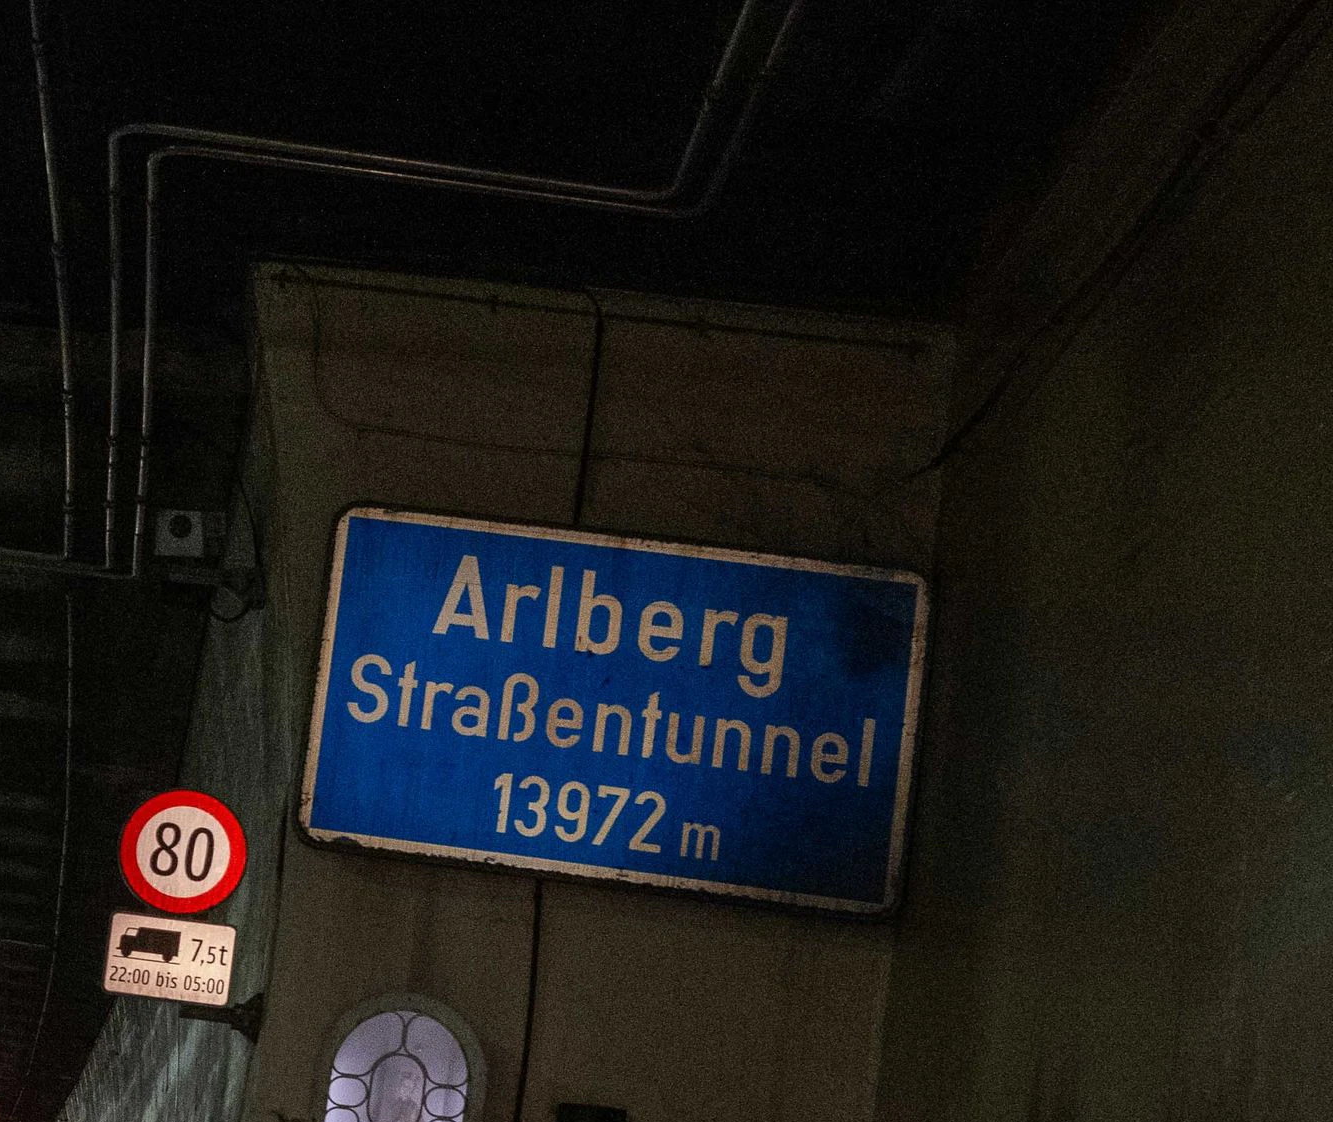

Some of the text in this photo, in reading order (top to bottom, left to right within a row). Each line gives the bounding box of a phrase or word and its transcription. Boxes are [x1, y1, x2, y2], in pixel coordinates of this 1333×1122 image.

[433, 555, 789, 698] Arlberg
[346, 654, 878, 788] Straßentunnel
[149, 822, 215, 882] 80
[492, 773, 722, 862] 13972 m
[109, 966, 226, 995] 22:00 bis 05:00
